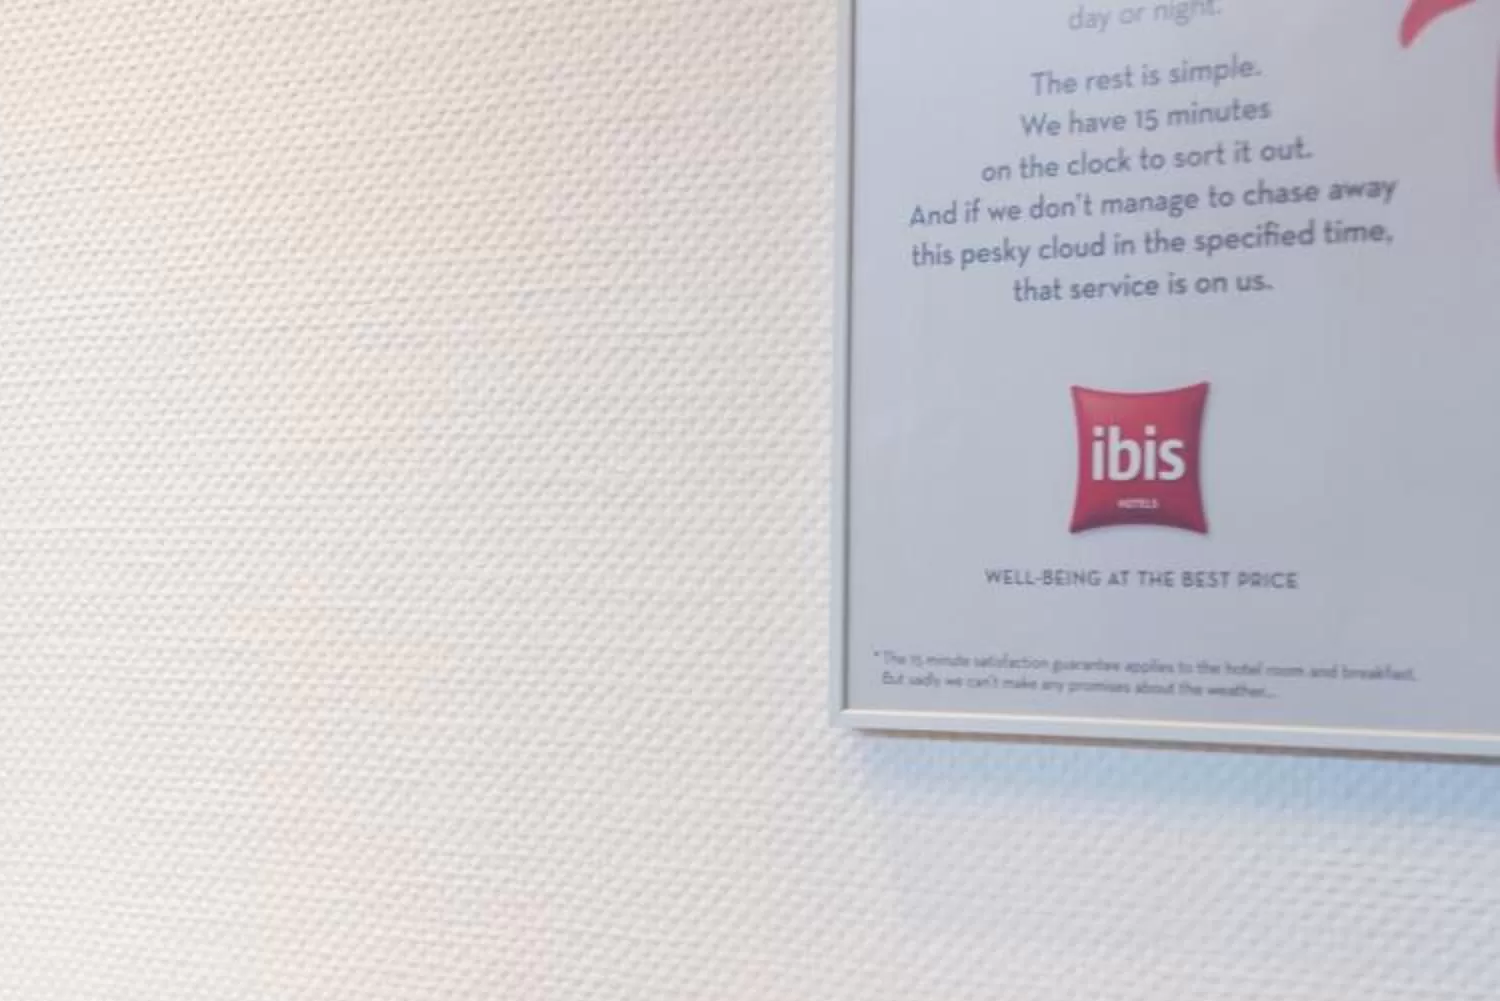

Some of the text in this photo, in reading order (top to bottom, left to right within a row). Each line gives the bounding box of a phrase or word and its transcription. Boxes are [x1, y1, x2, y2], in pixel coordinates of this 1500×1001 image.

[1068, 3, 1111, 33] day
[1119, 6, 1146, 24] or
[1030, 52, 1262, 96] The rest is simple.
[1019, 98, 1273, 137] We have 15 minutes
[981, 136, 1314, 182] on the clock to sort it out.
[908, 178, 1398, 227] And if we don't manage to chase away
[911, 218, 1394, 271] this pesky cloud in the specified time,
[1012, 271, 1274, 302] that service is on us.
[1092, 424, 1186, 481] ibis
[983, 568, 1299, 590] WELL-BEING AT THE BEST PRICE
